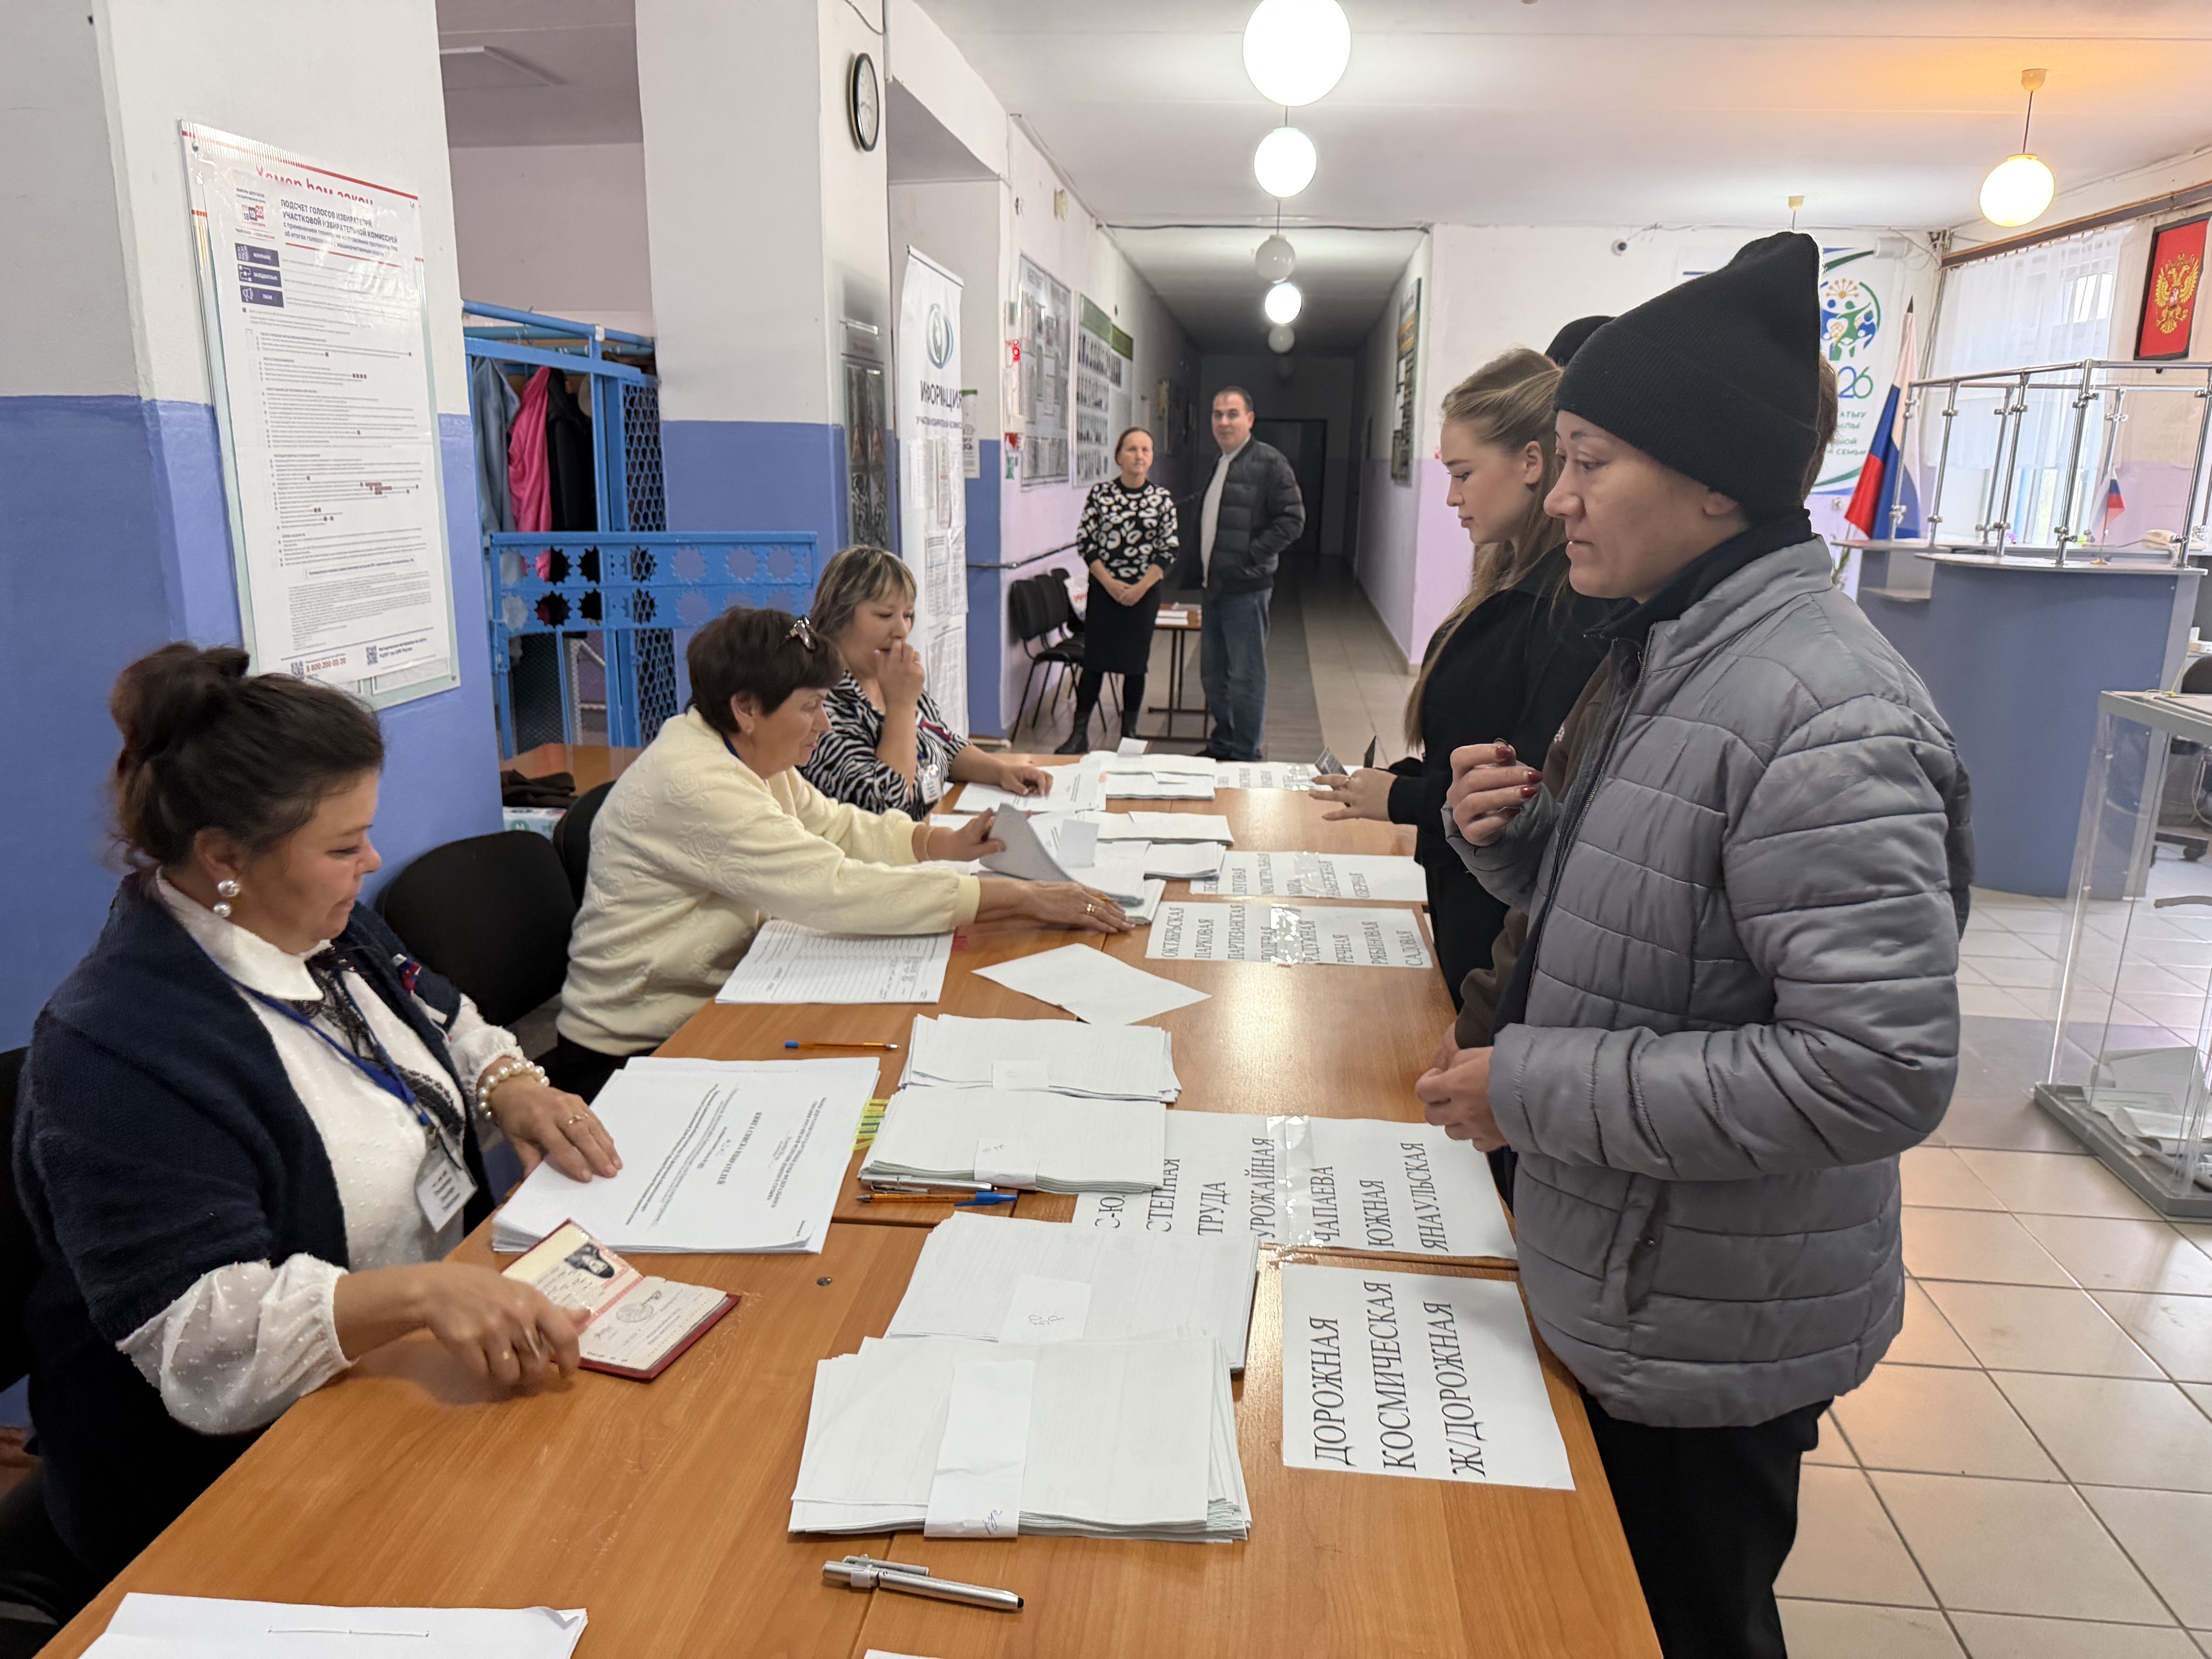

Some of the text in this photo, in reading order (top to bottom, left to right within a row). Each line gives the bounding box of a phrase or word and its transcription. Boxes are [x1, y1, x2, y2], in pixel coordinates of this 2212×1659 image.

[256, 208, 263, 216] 20
[281, 199, 372, 227] ПОДСЧЕТ ГОЛОСОВ ИЗБИРАТЕЛЕЙ
[282, 211, 322, 227] УЧАСТКОВОЙ
[323, 221, 366, 237] ИЗБИРАТЕЛЬНОЙ
[368, 232, 398, 244] КОМИССИЕЙ
[291, 233, 306, 241] итогах
[1162, 907, 1183, 958] ОКТЯБРЬСКАЯ
[1195, 919, 1214, 958] ПАРКОВАЯ
[1228, 905, 1245, 960] ПАРТИЗАНСКАЯ
[1261, 926, 1278, 961] ПОЛЕВАЯ
[1299, 921, 1321, 962] РАДУЖНАЯ
[1333, 934, 1354, 963] РЕЧНАЯ
[1362, 921, 1388, 965] РЯБИНОВАЯ
[1396, 930, 1423, 966] САДОВАЯ
[1197, 1181, 1231, 1237] ТРУДА
[1244, 1137, 1276, 1240] УРОЖАЙНАЯ
[1309, 1166, 1340, 1243] ЧАПАЕВА
[1399, 1141, 1449, 1252] ЯНАУЛЬСКАЯ
[1358, 1179, 1395, 1248] ЮЖНАЯ
[1310, 1316, 1357, 1467] ДОРОЖНАЯ
[1364, 1280, 1417, 1472] КОСМИЧЕСКАЯ
[1424, 1300, 1486, 1477] Ж/ДОРОЖНАЯ
